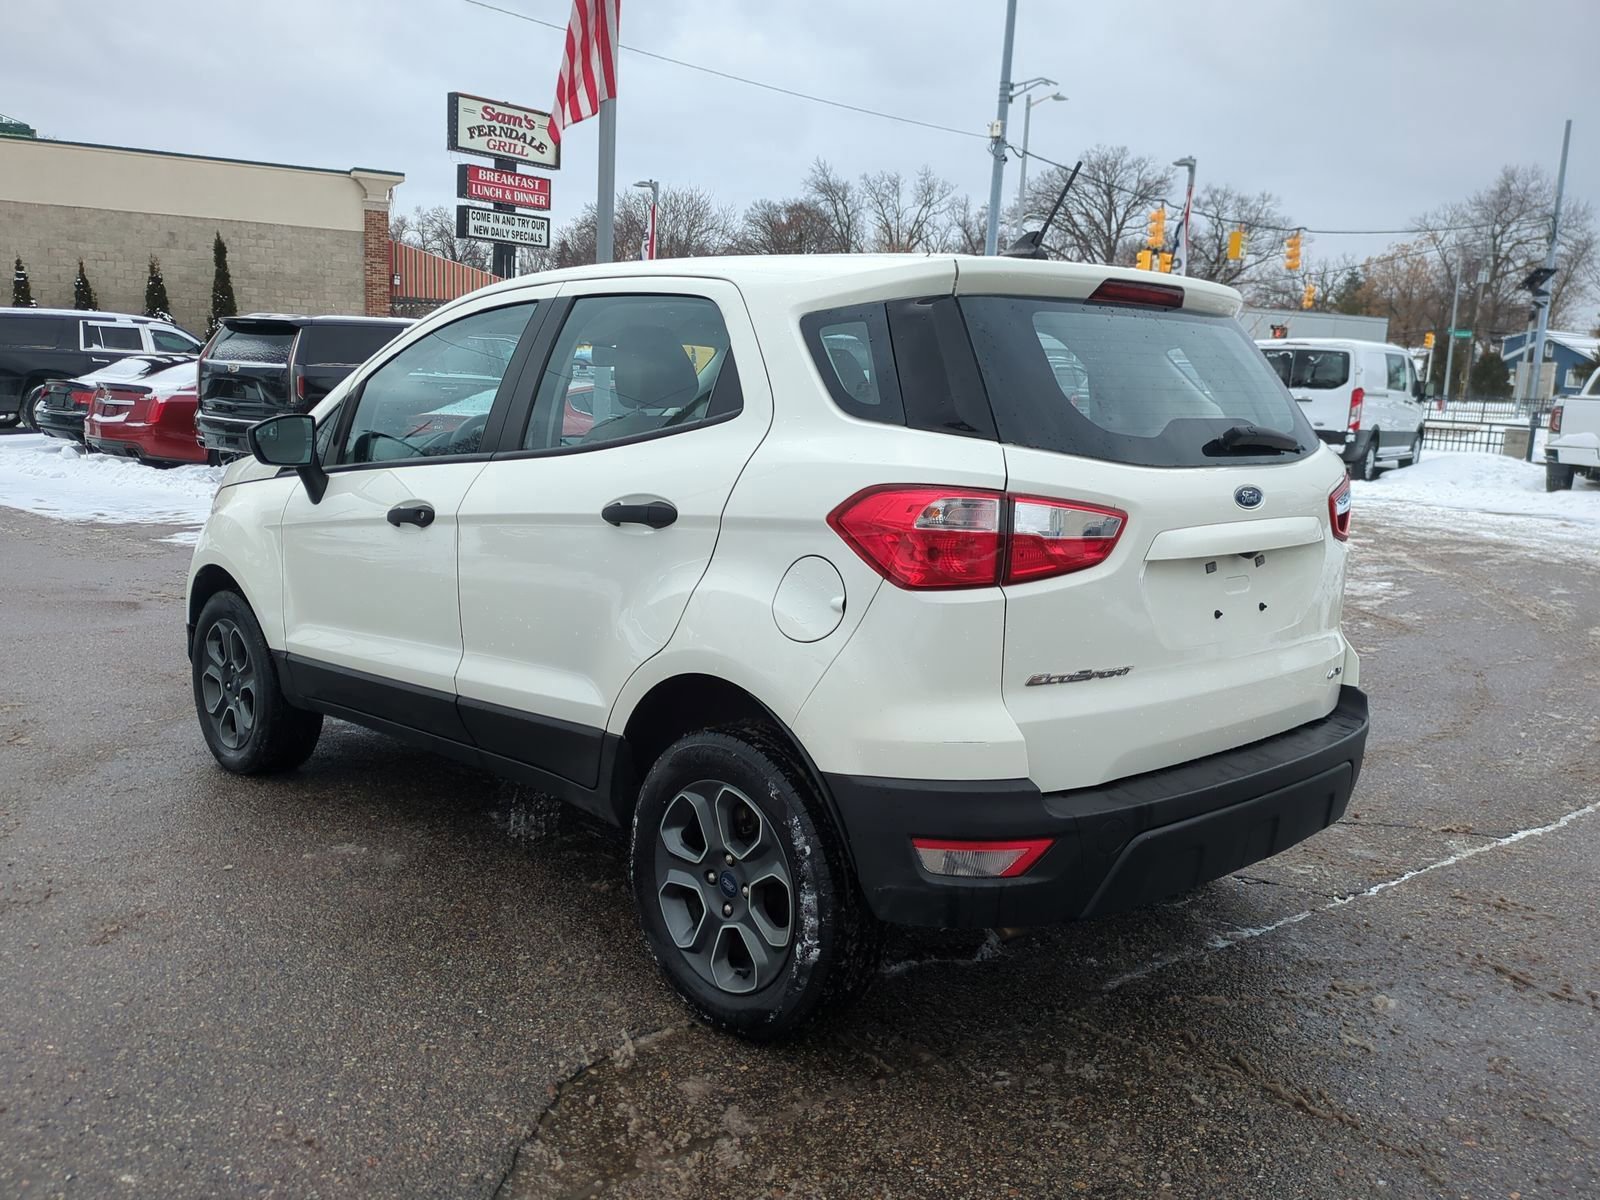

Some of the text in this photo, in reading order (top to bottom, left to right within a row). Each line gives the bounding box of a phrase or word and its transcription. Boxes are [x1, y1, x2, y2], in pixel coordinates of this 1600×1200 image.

[481, 105, 536, 130] Sam's
[467, 125, 547, 154] FERNDALE
[487, 138, 529, 157] GRILL
[478, 169, 540, 190] BREAKFAST
[472, 183, 546, 206] LUNCH & DINNER
[471, 210, 545, 231] COME IN AND TRY OUR
[474, 224, 543, 243] NEW DAILY SPECIALS
